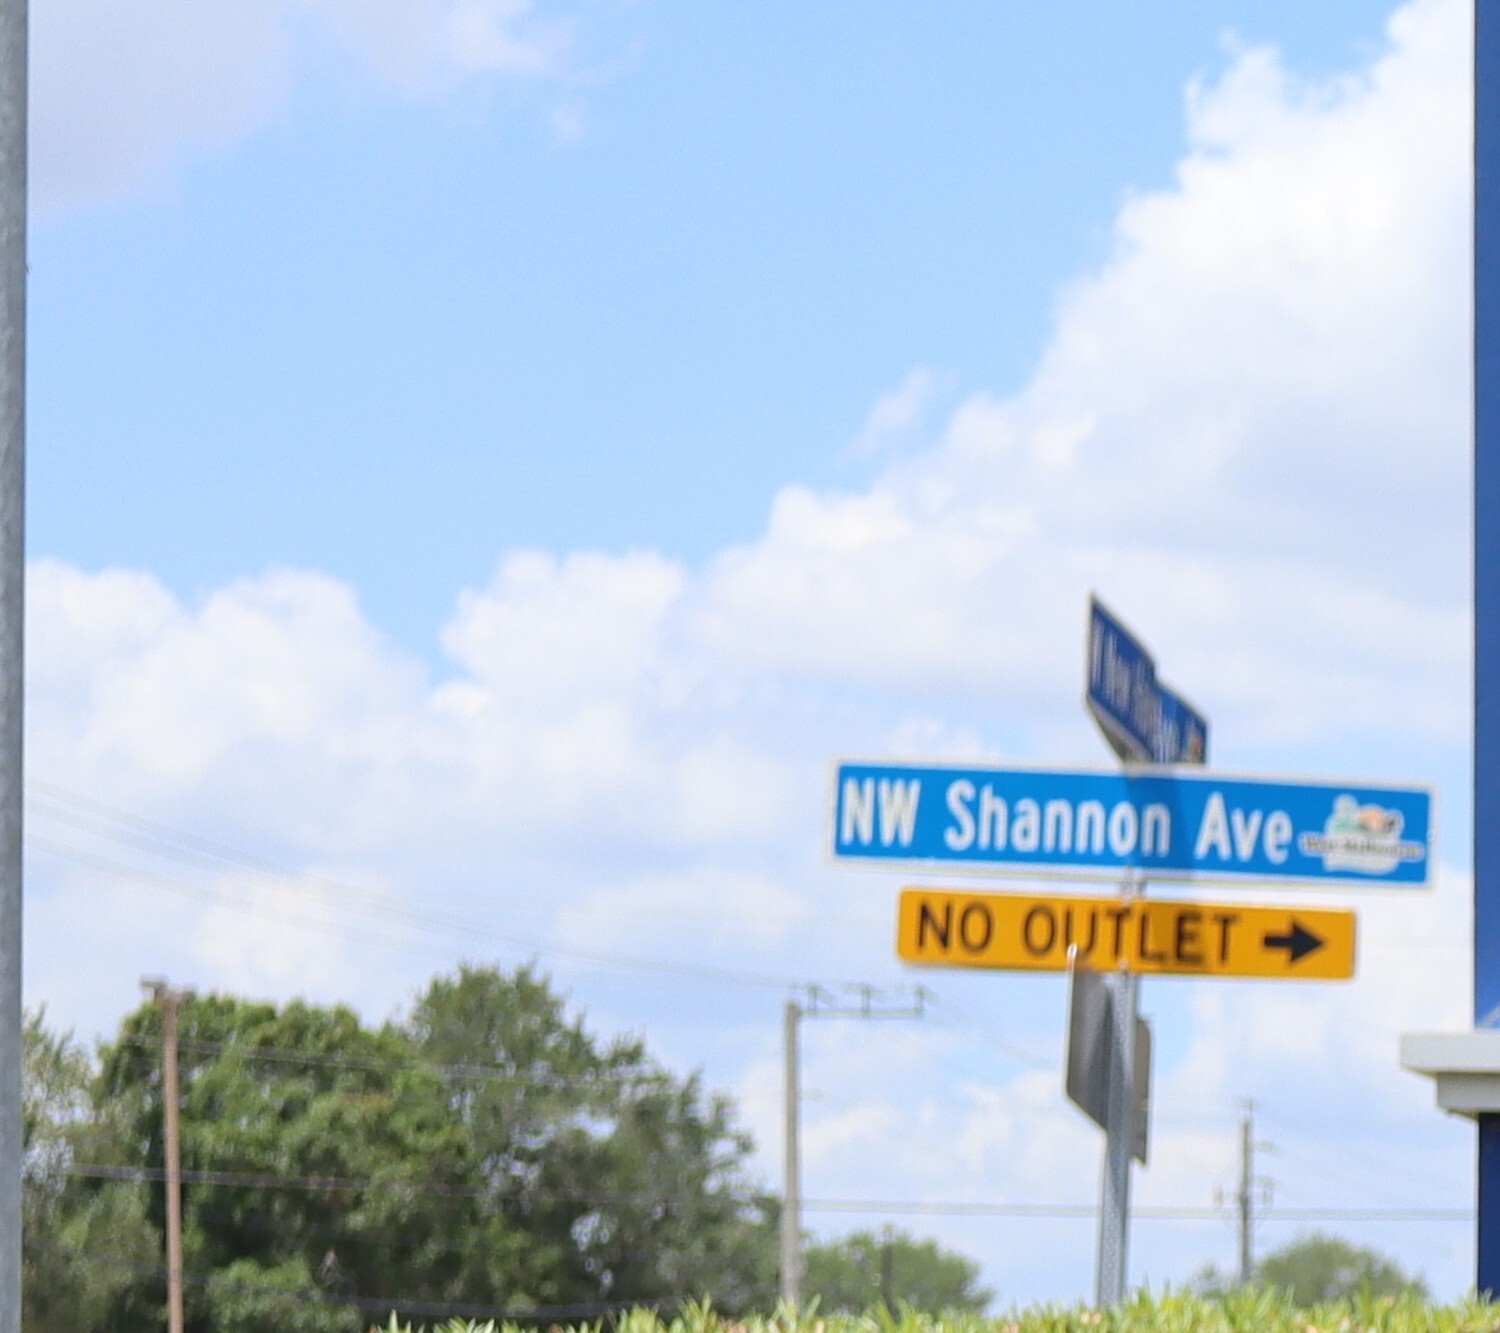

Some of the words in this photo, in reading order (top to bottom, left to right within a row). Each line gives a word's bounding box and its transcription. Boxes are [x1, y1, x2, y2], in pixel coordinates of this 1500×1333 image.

[841, 777, 922, 847] NW
[944, 779, 1172, 858] Shannon
[1194, 791, 1291, 863] Ave
[917, 903, 992, 954] NO
[1023, 905, 1240, 966] OUTLET
